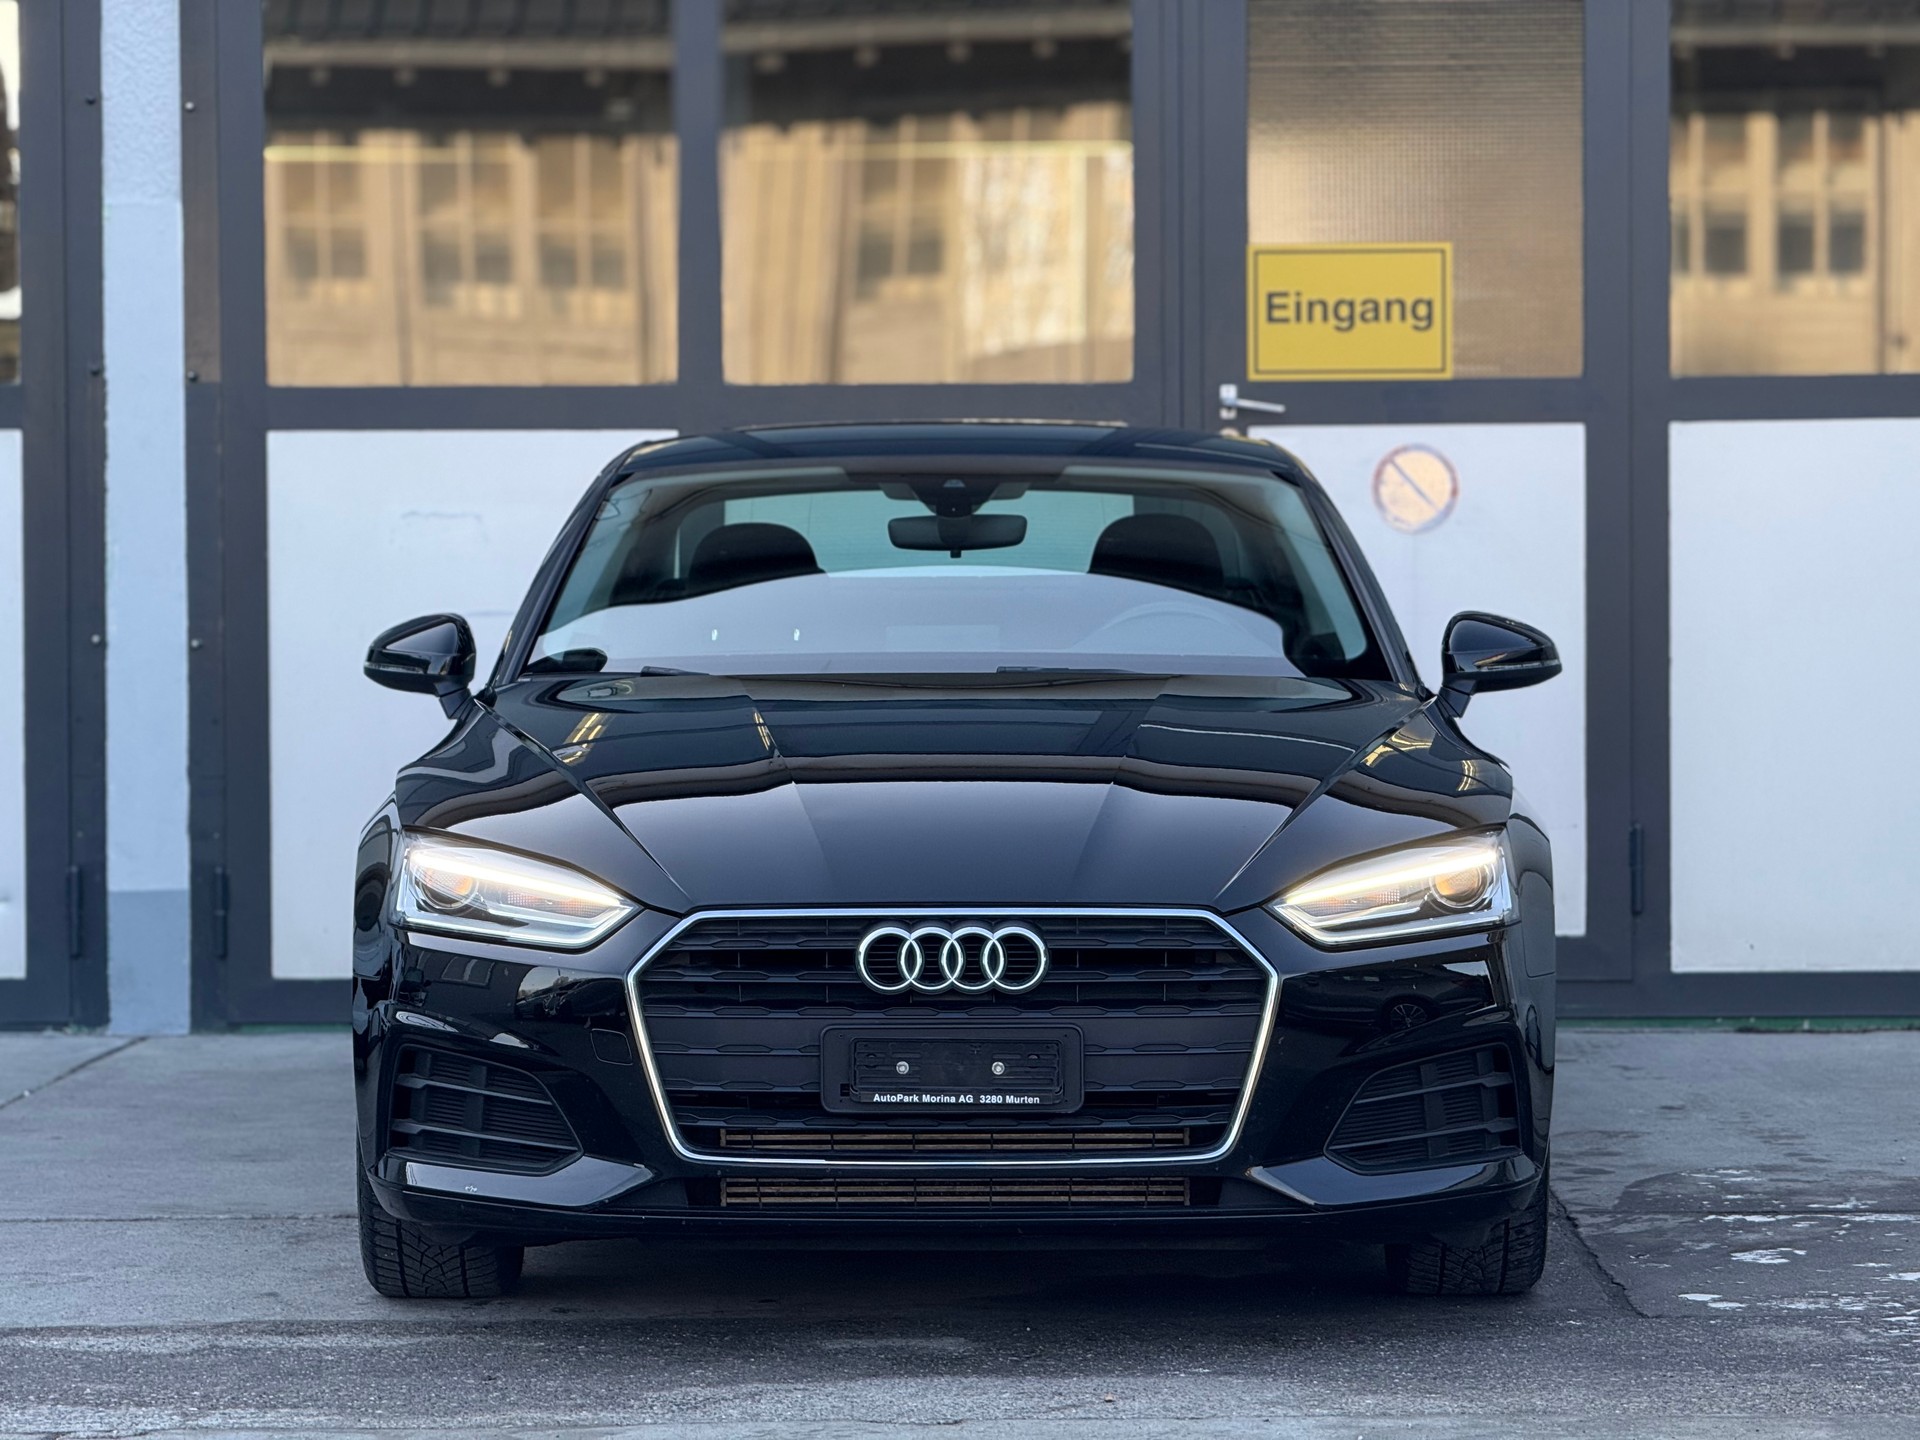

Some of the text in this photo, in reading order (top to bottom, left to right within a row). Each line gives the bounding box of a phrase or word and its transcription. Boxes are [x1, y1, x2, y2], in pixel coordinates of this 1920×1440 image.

[1266, 291, 1433, 331] Eingang
[873, 1093, 1040, 1104] AutoPark Morina AG 3280 Murten
